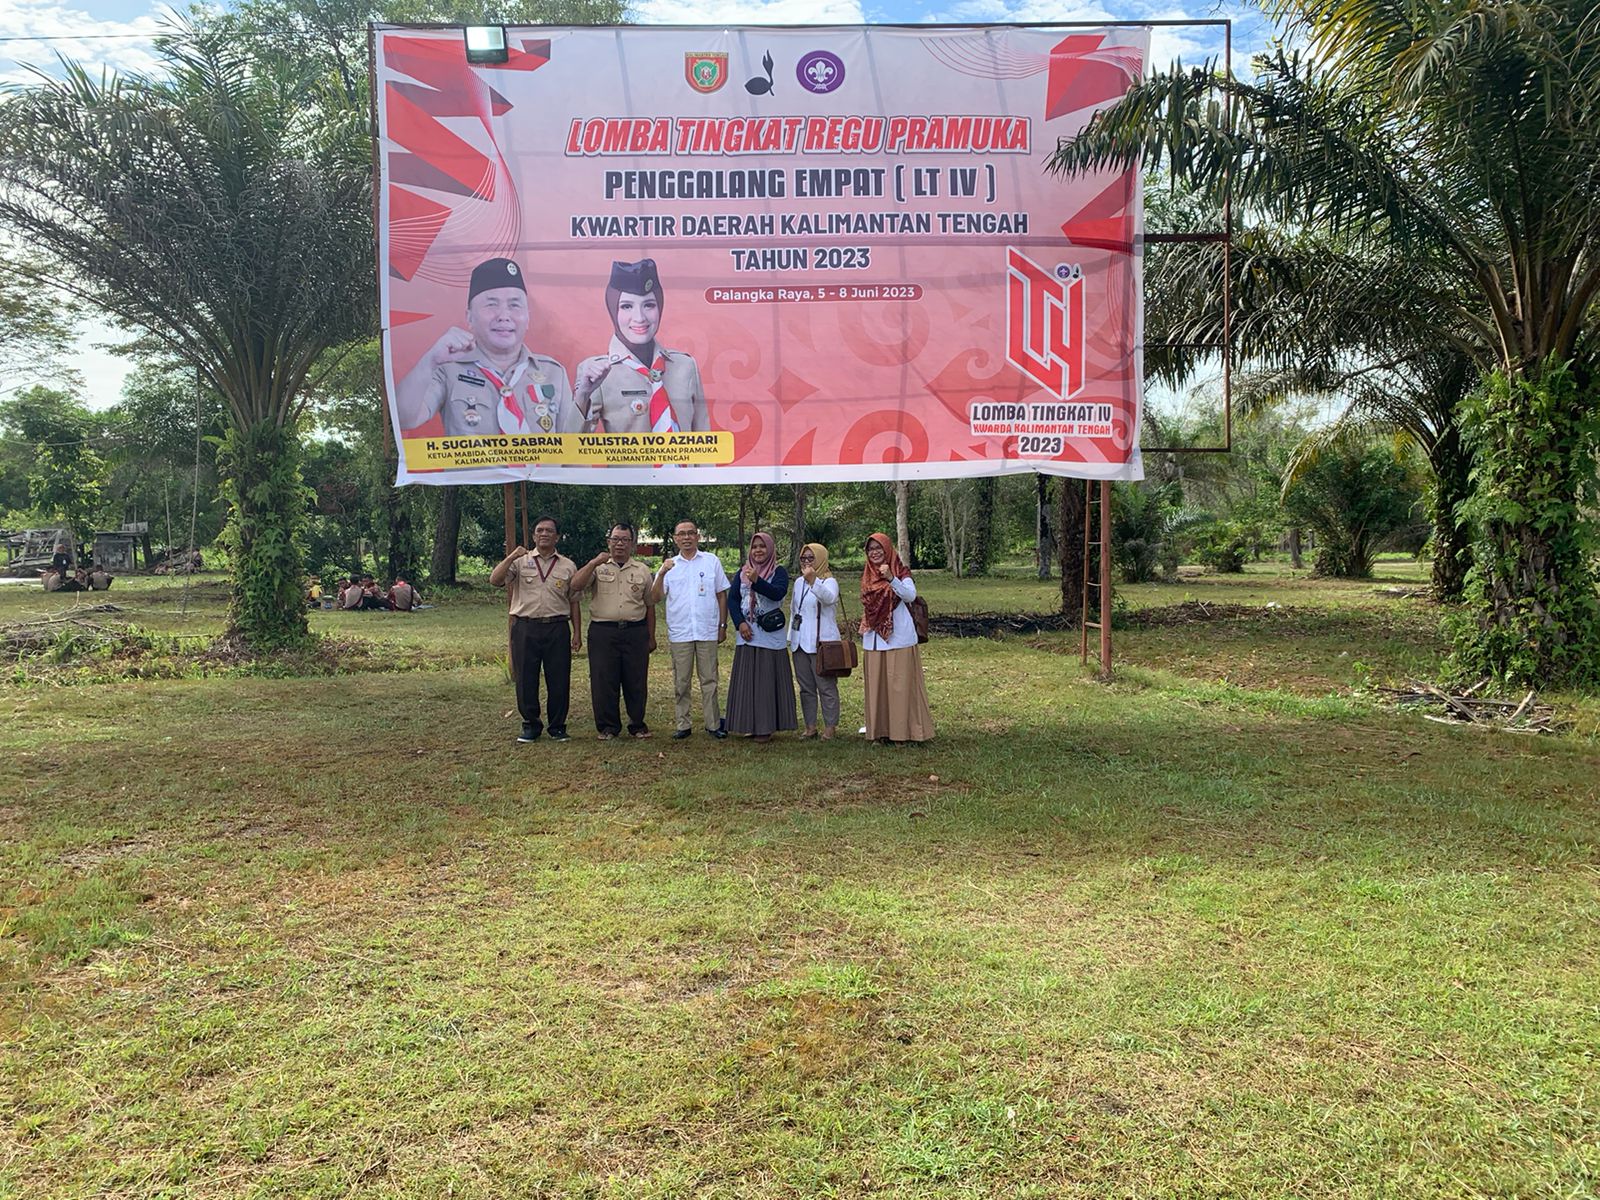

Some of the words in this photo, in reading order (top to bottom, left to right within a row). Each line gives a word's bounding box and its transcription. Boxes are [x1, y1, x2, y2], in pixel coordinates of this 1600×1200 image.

[566, 117, 671, 155] LOMBA
[676, 117, 804, 154] TINGKAT
[803, 117, 884, 153] REGU
[886, 116, 1030, 153] PRAMUKA
[604, 169, 786, 199] PENGGALANG
[795, 168, 886, 197] EMPAT
[571, 216, 676, 237] KWARTIR
[682, 215, 774, 236] DAERAH
[781, 213, 931, 235] KALIMANTAN
[937, 213, 1028, 234] TENGAH
[731, 249, 808, 271] TAHUN
[814, 248, 870, 269] 2023
[713, 289, 774, 303] Palangka
[778, 289, 815, 301] Raya,
[818, 287, 826, 298] 5
[839, 287, 848, 298] 8
[851, 286, 879, 298] Juni
[882, 287, 915, 298] 2023
[973, 405, 1026, 421] LOMBA
[1032, 405, 1094, 421] TINGKAT
[1098, 406, 1111, 422] IV
[973, 423, 1012, 434] KWARDA
[1014, 423, 1074, 434] KALIMANTAN
[1078, 424, 1111, 435] TENGAH
[426, 441, 439, 451] H.
[442, 438, 509, 450] SUGIANTO
[512, 436, 563, 447] SABRAN
[578, 436, 640, 446] YULISTRA
[642, 436, 665, 445] IVO
[669, 435, 718, 445] AZHARI
[1020, 436, 1062, 453] 2023
[454, 450, 487, 458] MABIDA
[604, 447, 638, 455] KWARDA
[679, 446, 718, 454] PRAMUKA
[454, 457, 508, 465] KALIMANTAN
